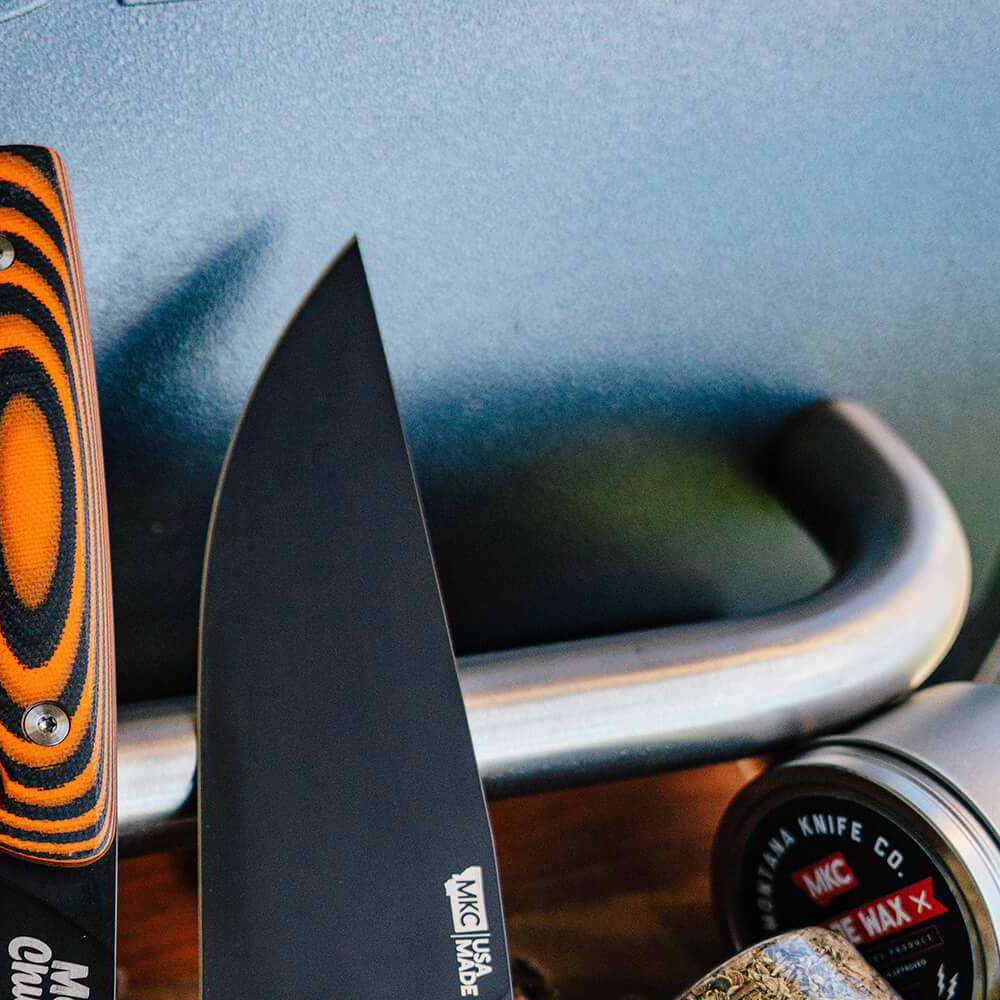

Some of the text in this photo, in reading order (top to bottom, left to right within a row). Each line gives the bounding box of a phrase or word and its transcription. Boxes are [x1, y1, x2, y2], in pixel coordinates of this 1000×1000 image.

[797, 813, 863, 843] KNIFE
[873, 835, 904, 878] CO.
[802, 858, 851, 897] MKC
[456, 880, 480, 927] MKC
[858, 895, 911, 937] WAX
[455, 939, 479, 997] MADE
[472, 938, 493, 978] USA
